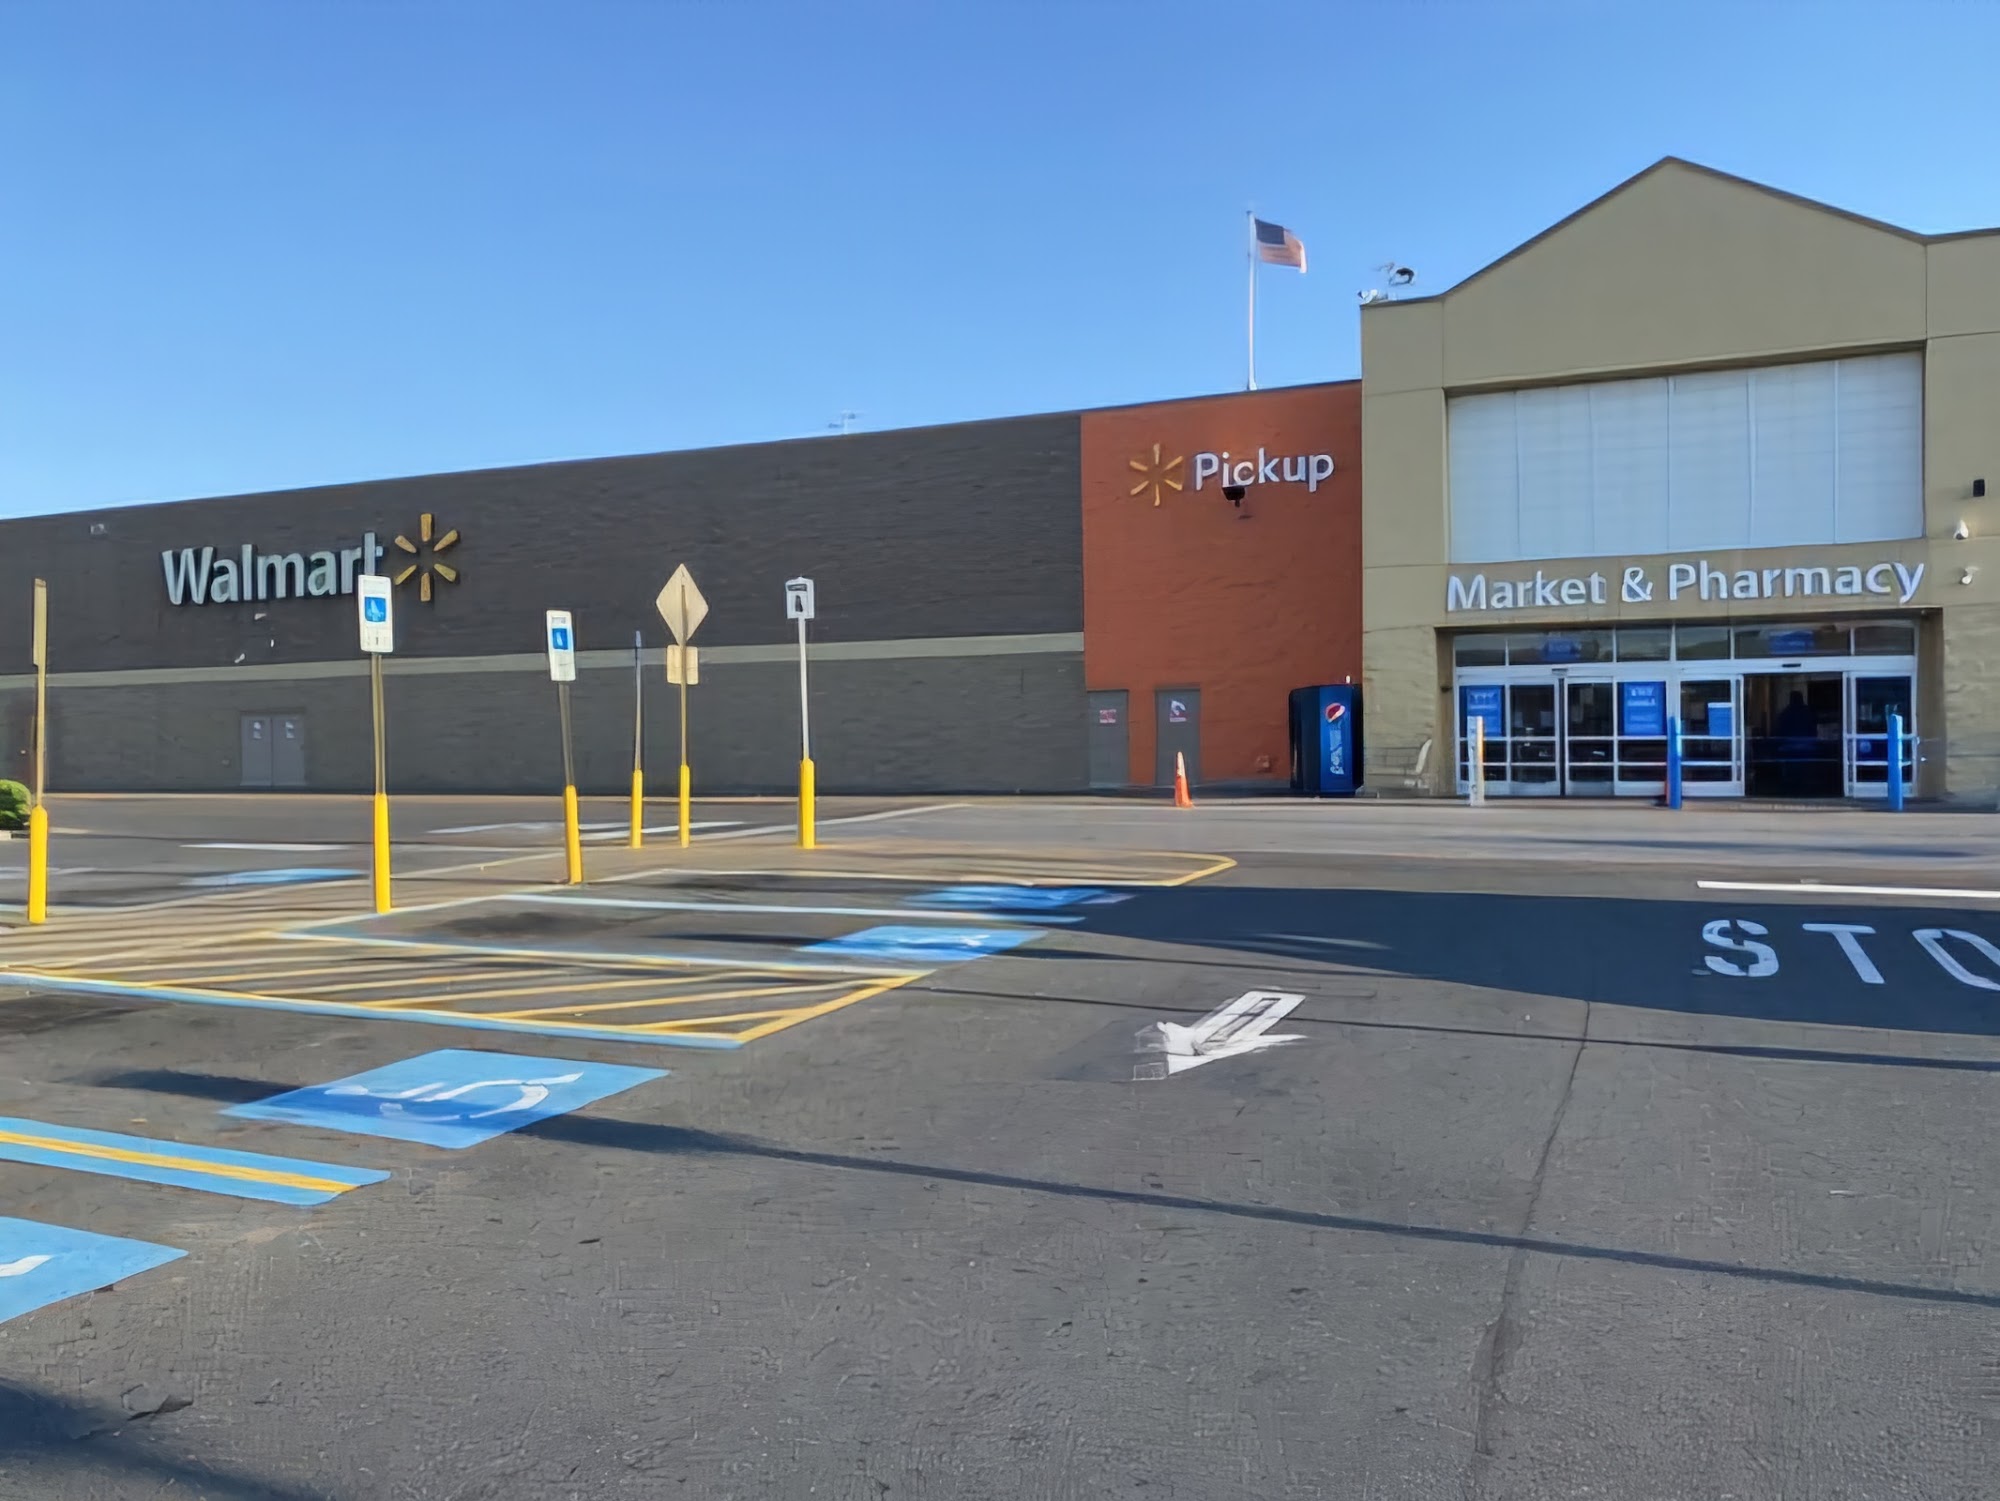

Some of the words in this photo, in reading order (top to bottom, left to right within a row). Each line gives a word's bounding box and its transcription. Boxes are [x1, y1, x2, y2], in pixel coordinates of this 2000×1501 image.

[1195, 447, 1335, 493] Pickup
[161, 531, 384, 605] Walmart
[1447, 570, 1607, 611] Market
[1622, 567, 1653, 602] &
[1669, 560, 1925, 604] Pharmacy
